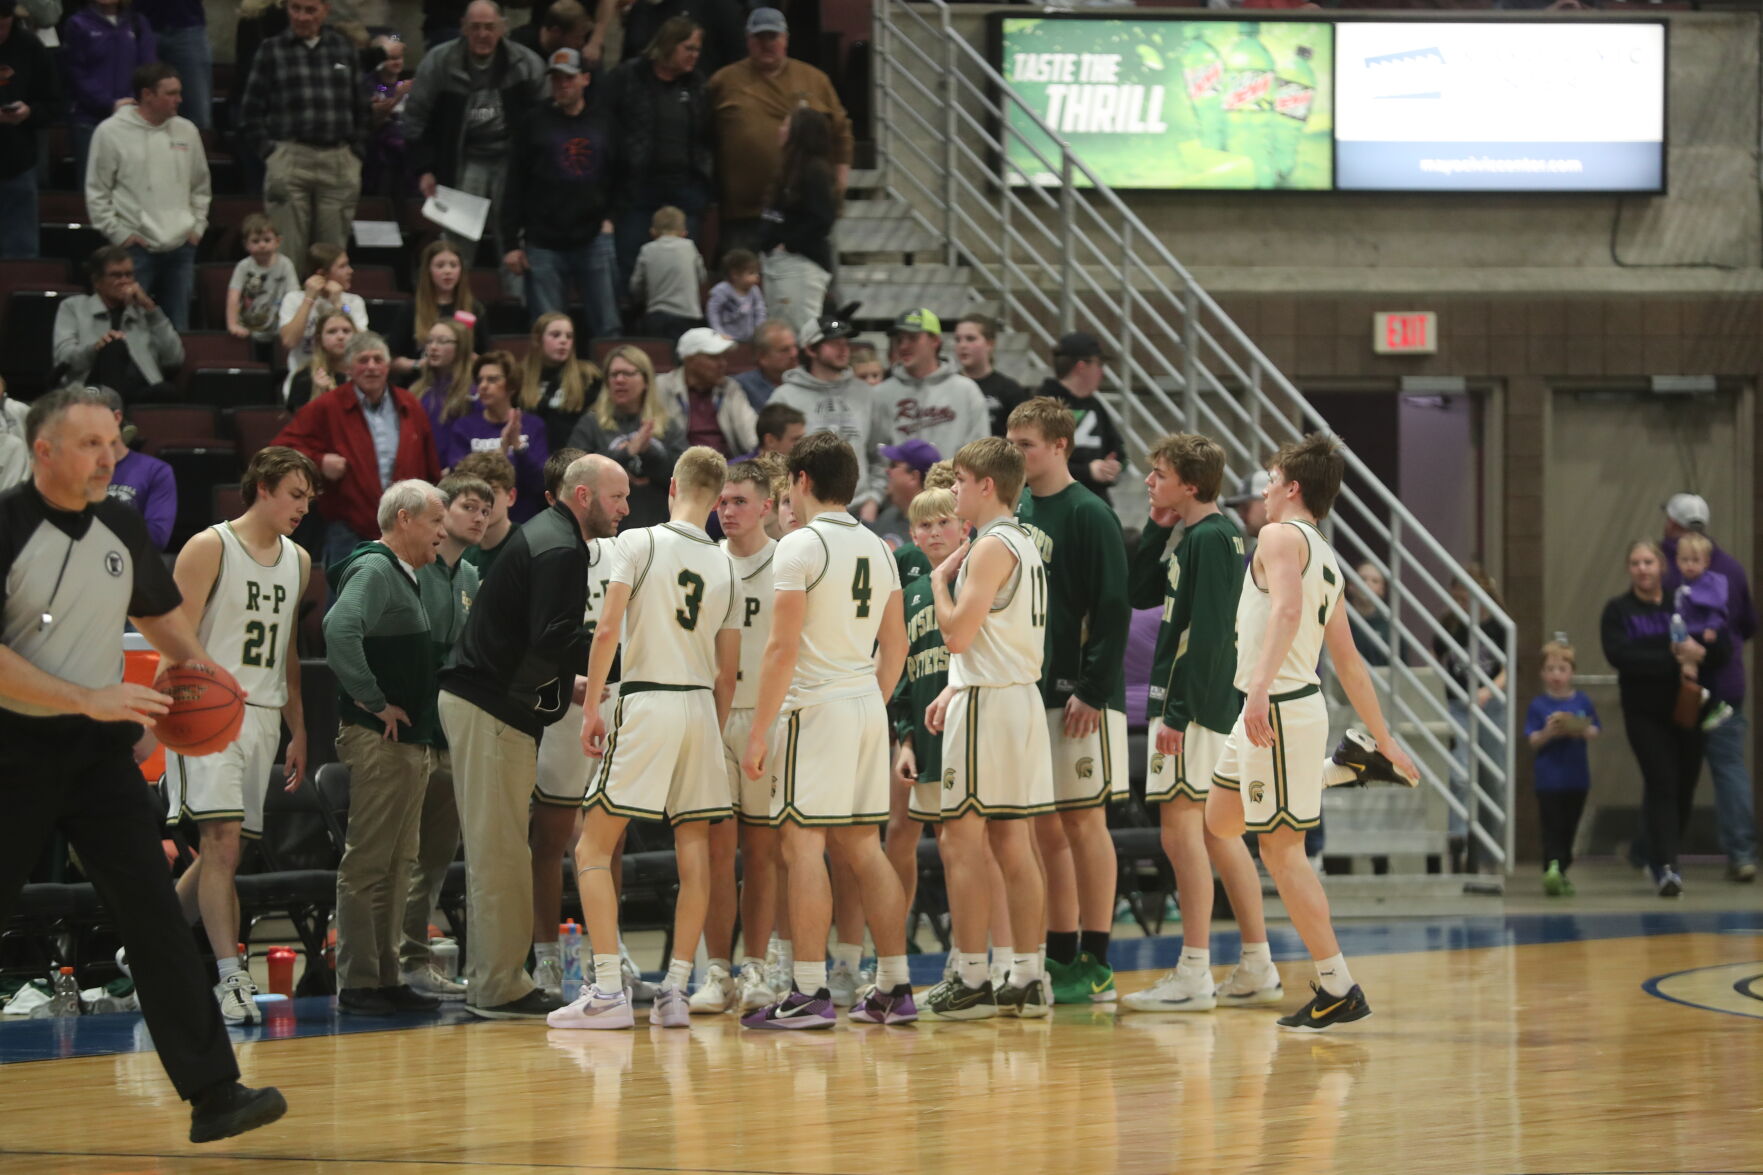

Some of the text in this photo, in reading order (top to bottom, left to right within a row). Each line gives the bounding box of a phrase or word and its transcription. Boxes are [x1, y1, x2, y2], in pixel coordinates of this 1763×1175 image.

[1013, 53, 1122, 83] TASTE THE
[1045, 84, 1168, 133] THRILL
[1386, 314, 1427, 350] EXIT
[246, 580, 286, 614] R-P
[676, 568, 704, 632] 3
[852, 556, 872, 618] 4
[1030, 565, 1045, 627] 11
[242, 619, 279, 669] 21
